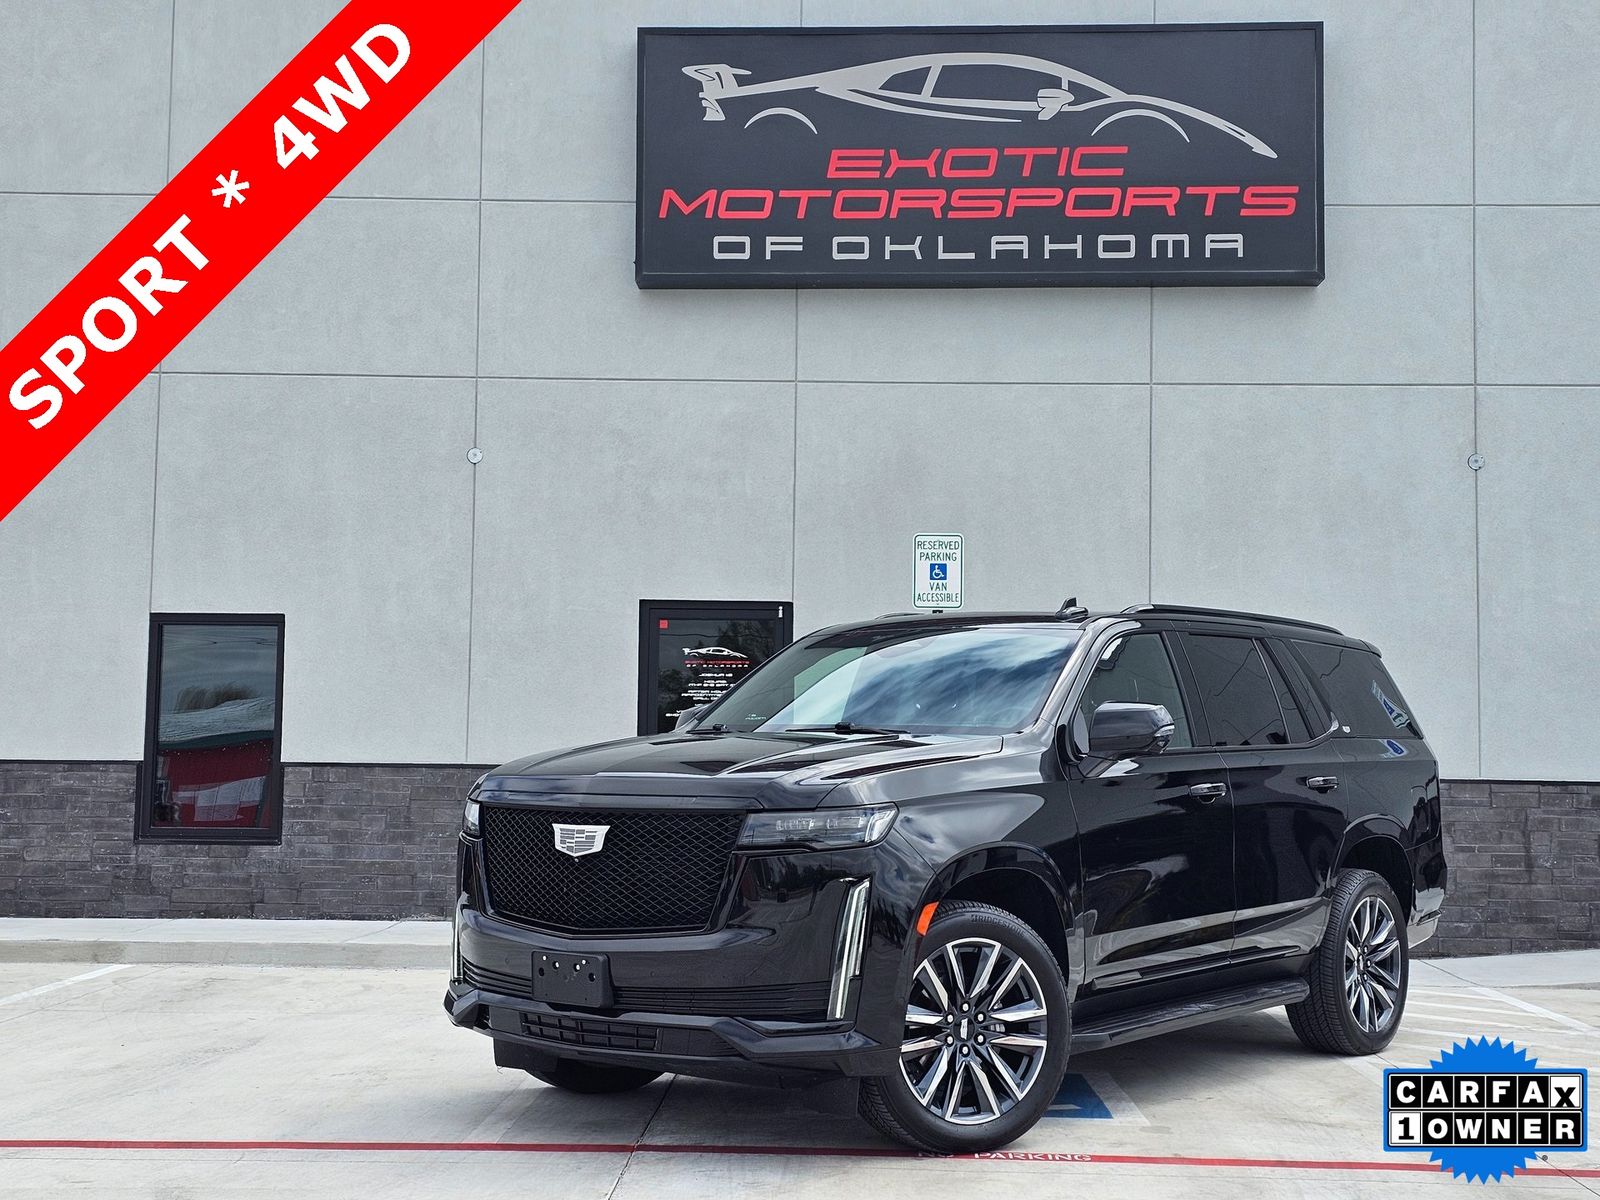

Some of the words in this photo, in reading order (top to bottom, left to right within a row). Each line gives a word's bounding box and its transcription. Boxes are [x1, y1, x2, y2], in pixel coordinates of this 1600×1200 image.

[826, 145, 1129, 179] EXOTIC
[658, 185, 1300, 220] MOTORSPORTS
[712, 235, 804, 260] OF
[832, 233, 1244, 260] OKLAHOMA
[917, 540, 960, 550] RESERVED
[919, 552, 957, 561] PARKING
[929, 582, 948, 591] VAN
[916, 592, 959, 603] ACCESSIBLE
[971, 914, 1025, 937] BRIDGESTONE
[974, 1152, 1092, 1161] PARKING
